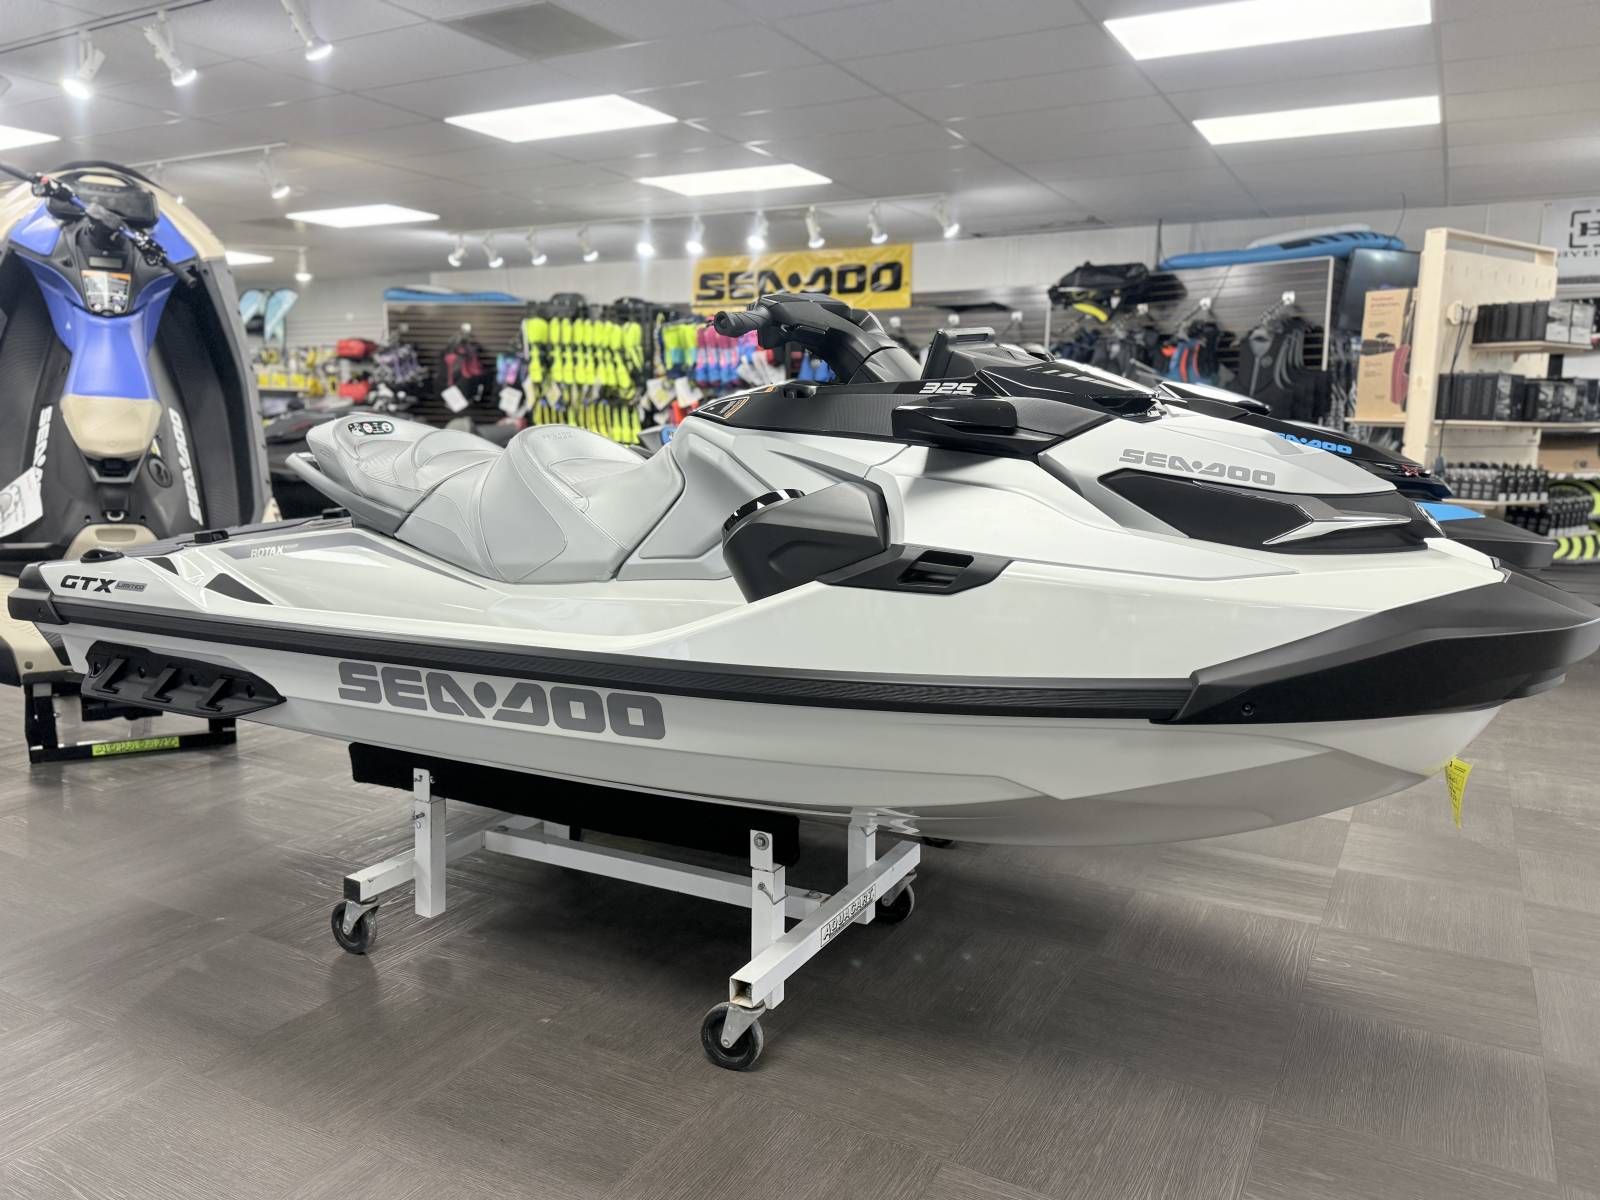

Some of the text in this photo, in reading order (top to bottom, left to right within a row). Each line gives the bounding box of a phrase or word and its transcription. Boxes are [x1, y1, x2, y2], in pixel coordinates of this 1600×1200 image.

[696, 261, 903, 301] SEA•DOO
[918, 382, 978, 395] 325
[1275, 431, 1353, 455] EA•DOO
[1118, 448, 1276, 487] SEA•DOO
[250, 545, 283, 559] ROTAX
[60, 574, 117, 593] GTX
[338, 660, 666, 741] SEA•DOO
